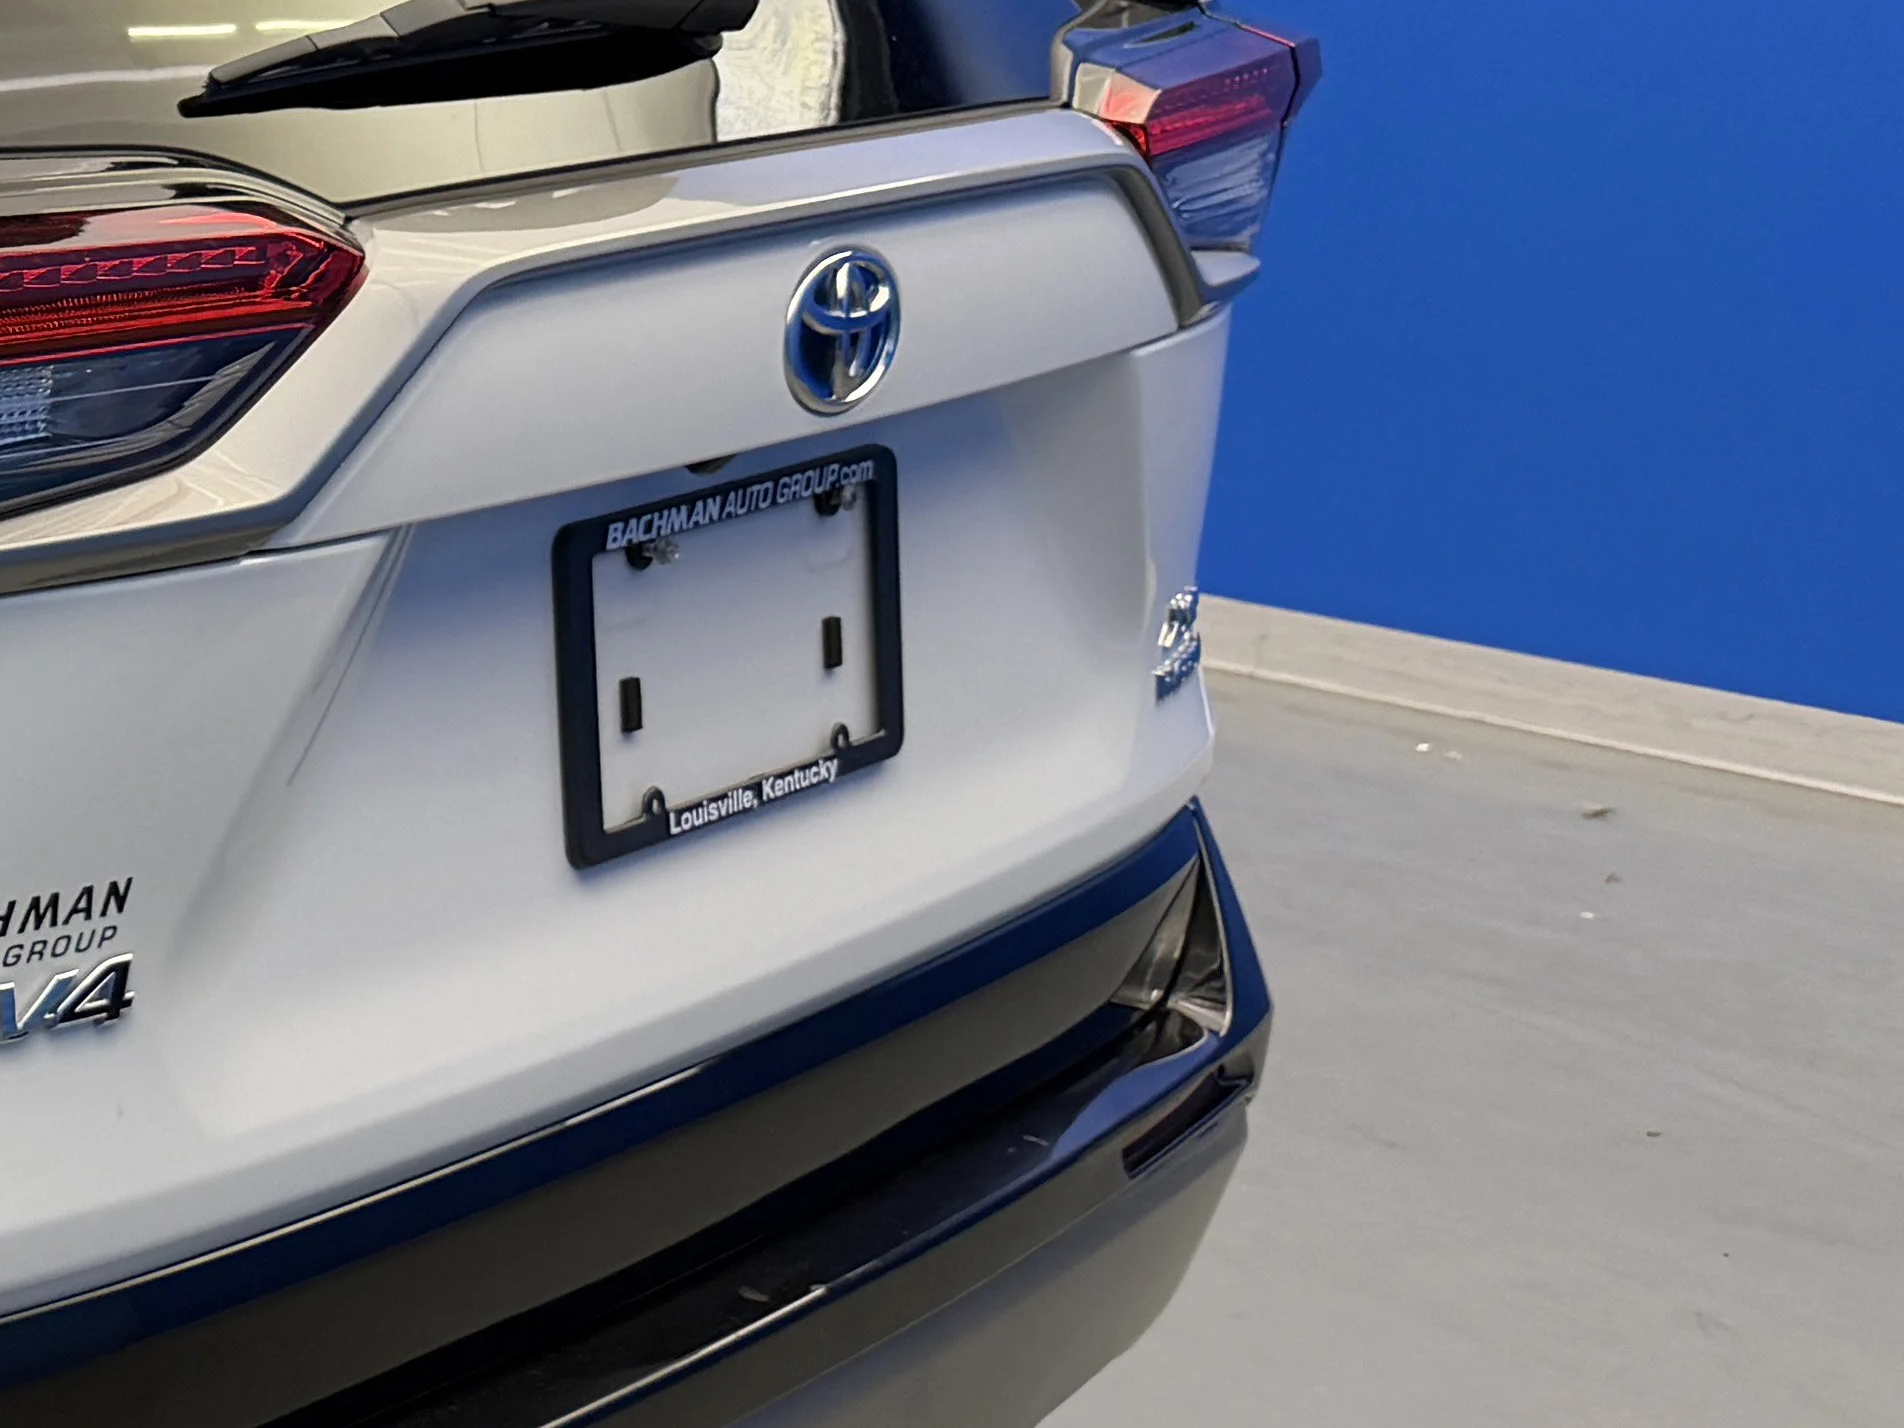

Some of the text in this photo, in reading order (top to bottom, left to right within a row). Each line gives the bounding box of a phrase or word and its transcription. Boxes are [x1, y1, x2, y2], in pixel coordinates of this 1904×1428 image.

[606, 495, 722, 551] BACHMAN
[722, 479, 774, 520] AUTO
[669, 754, 839, 835] Louisville, Kentucky
[2, 924, 118, 968] GROUP
